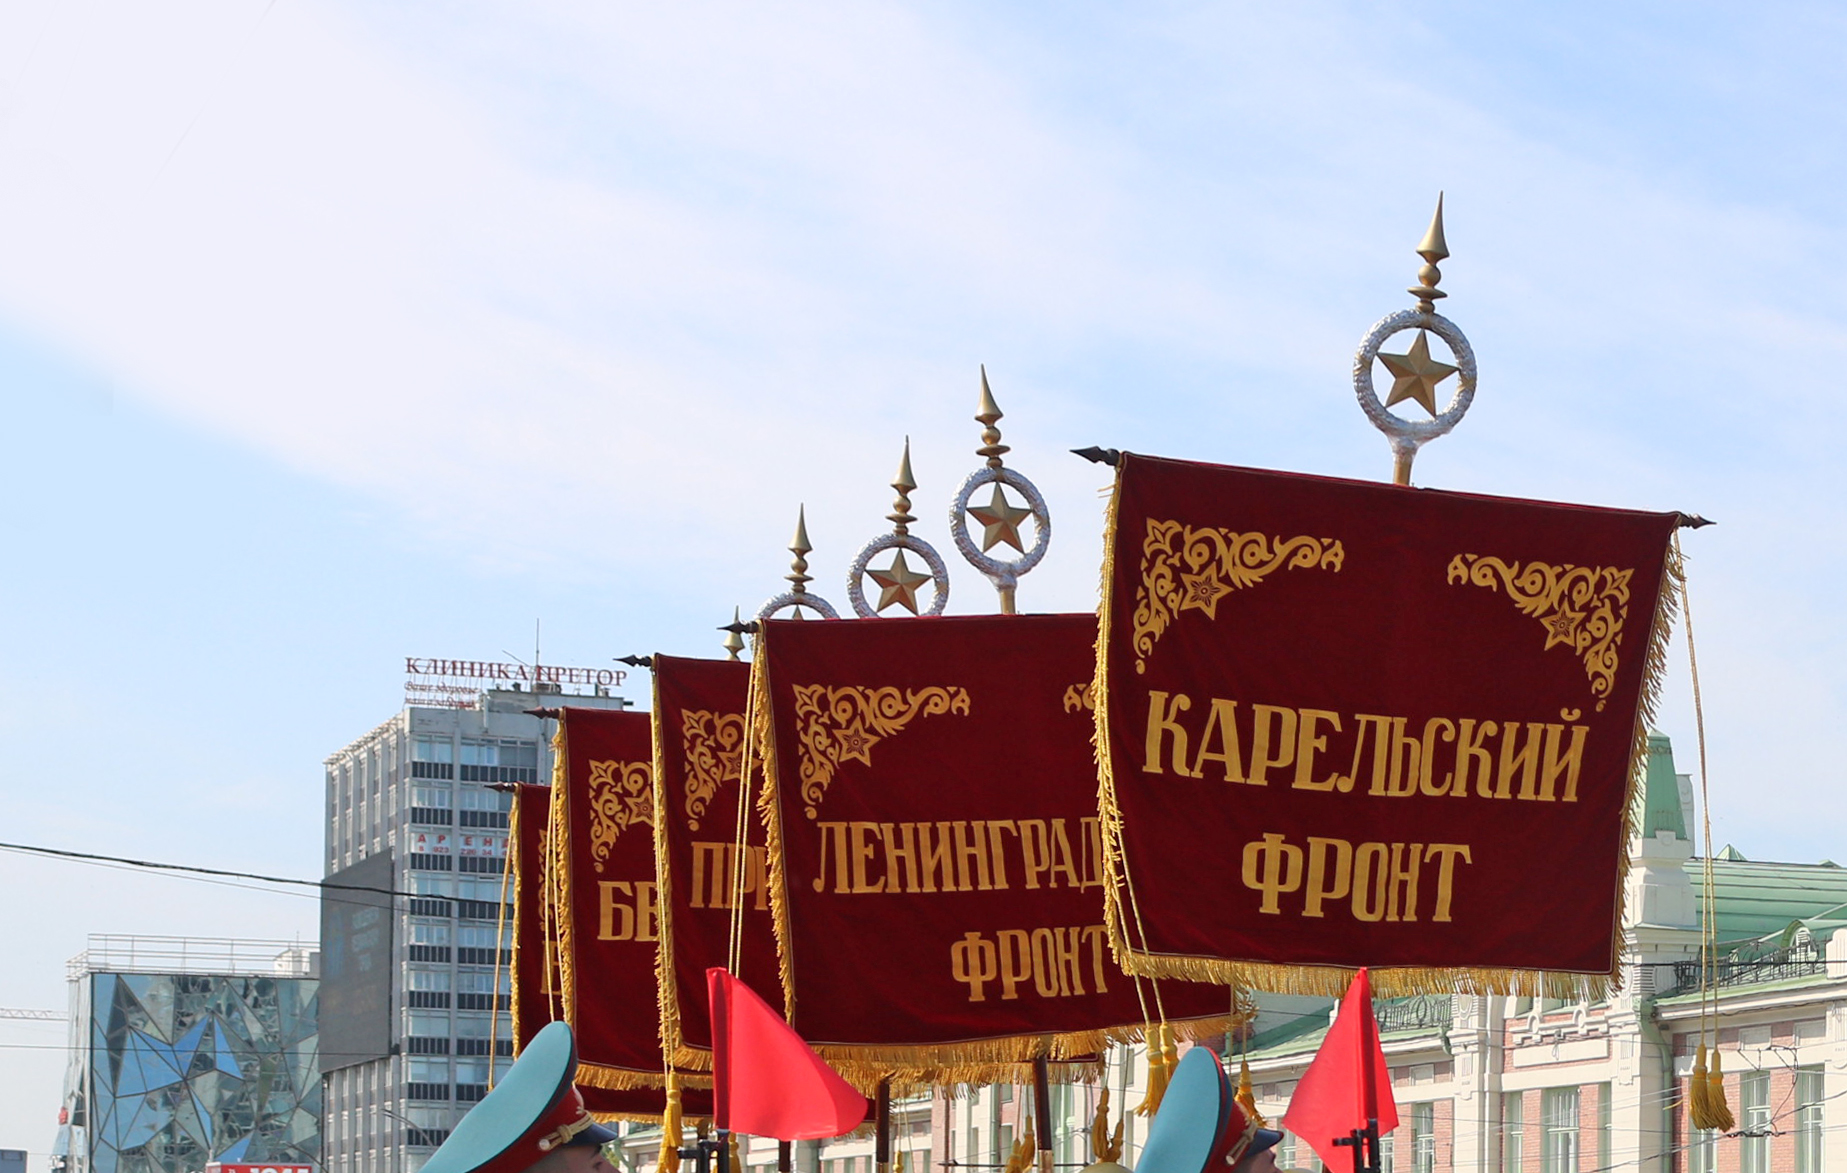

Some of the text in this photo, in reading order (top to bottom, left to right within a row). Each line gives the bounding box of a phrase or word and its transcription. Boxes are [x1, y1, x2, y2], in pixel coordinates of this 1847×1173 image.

[405, 657, 627, 687] КЛИНИКА ПРЕТОР
[1142, 690, 1590, 802] КАРЕЛЬСКИЙ
[1241, 832, 1472, 923] ФРОНТ
[950, 924, 1109, 1002] ФРОНТ
